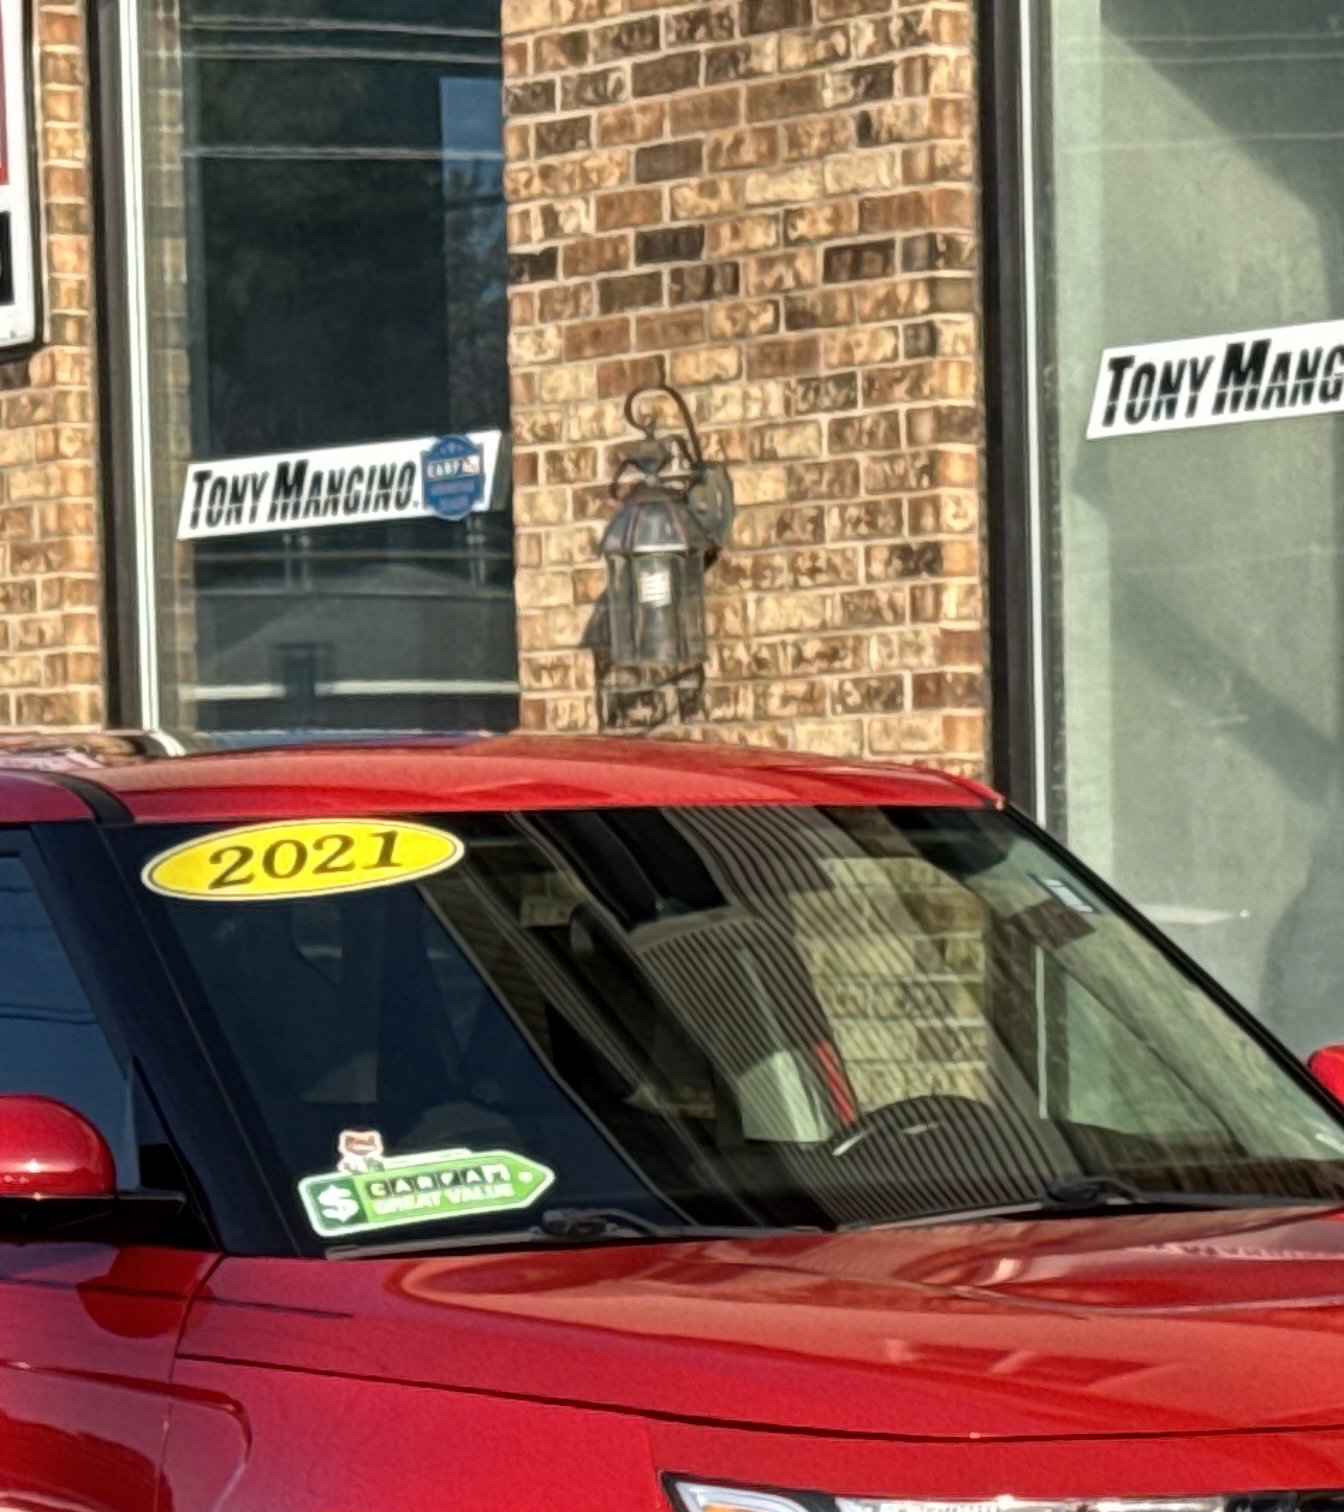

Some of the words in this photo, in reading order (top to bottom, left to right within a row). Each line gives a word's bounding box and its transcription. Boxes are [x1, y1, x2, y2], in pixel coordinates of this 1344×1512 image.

[1101, 354, 1215, 427] TONY
[189, 470, 271, 530] TONY
[208, 830, 404, 891] 2021
